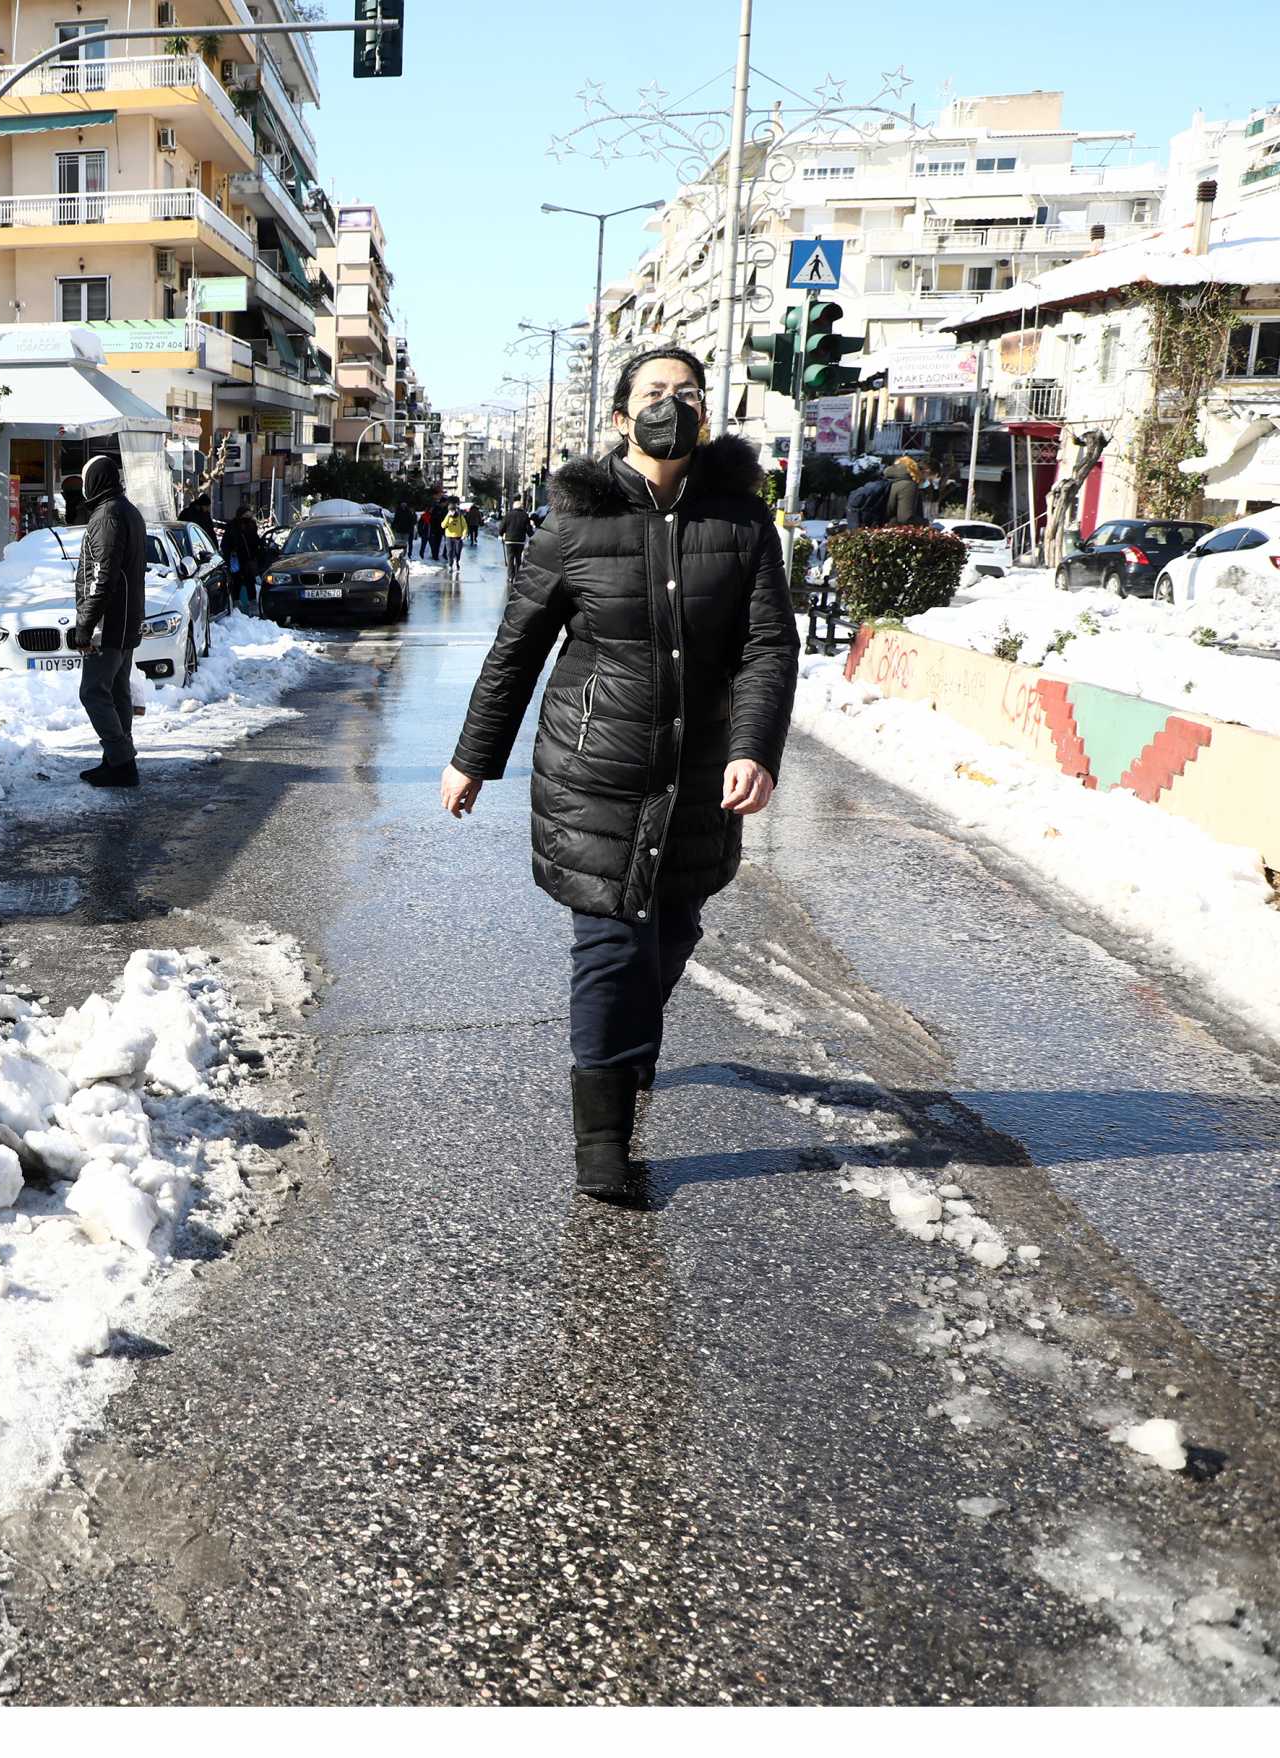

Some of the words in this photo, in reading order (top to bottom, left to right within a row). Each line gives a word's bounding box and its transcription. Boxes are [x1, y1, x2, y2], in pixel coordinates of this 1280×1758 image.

[130, 342, 143, 350] 210
[145, 342, 154, 350] 72
[156, 341, 166, 349] 47
[167, 341, 183, 349] 404
